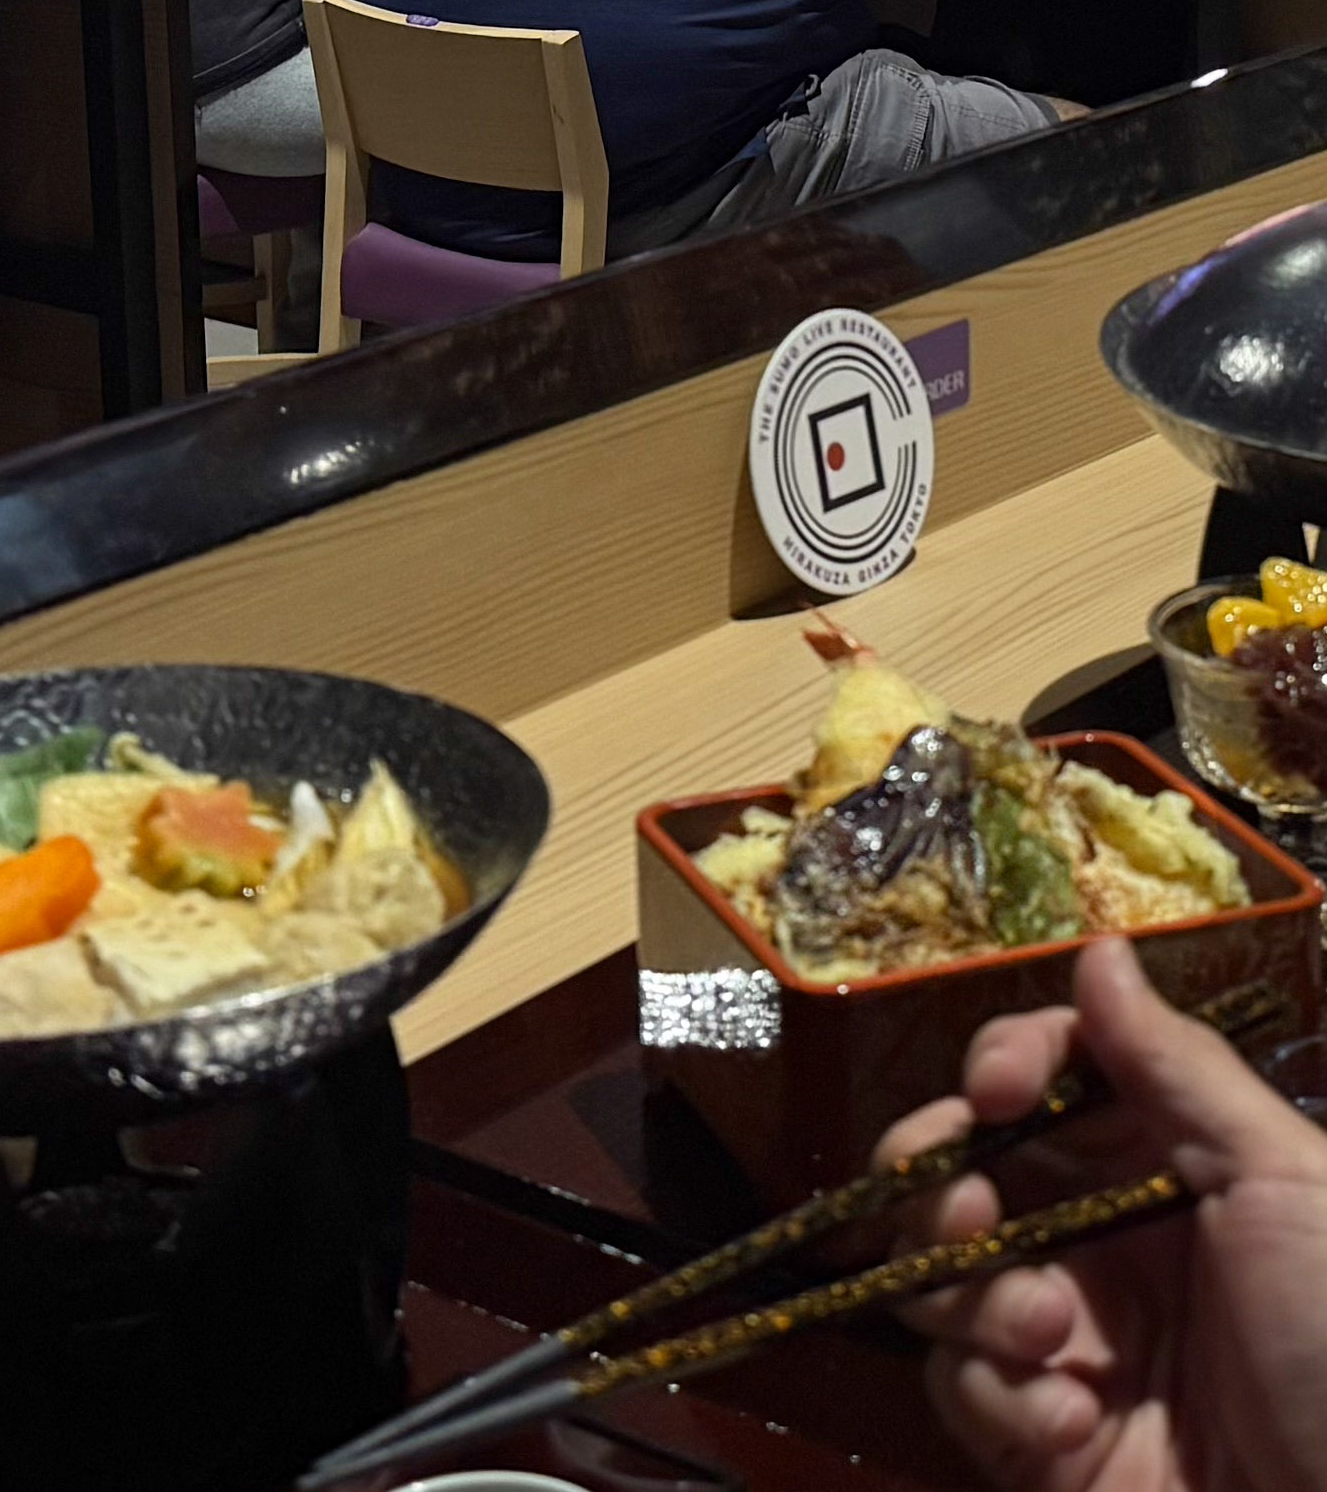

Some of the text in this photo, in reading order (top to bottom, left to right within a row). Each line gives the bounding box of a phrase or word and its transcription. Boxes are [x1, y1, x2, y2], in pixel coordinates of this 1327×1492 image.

[758, 318, 916, 445] THE SUMO LIVE RESTAURANT
[783, 483, 927, 585] HIRAKUZA GINZA TOKYO
